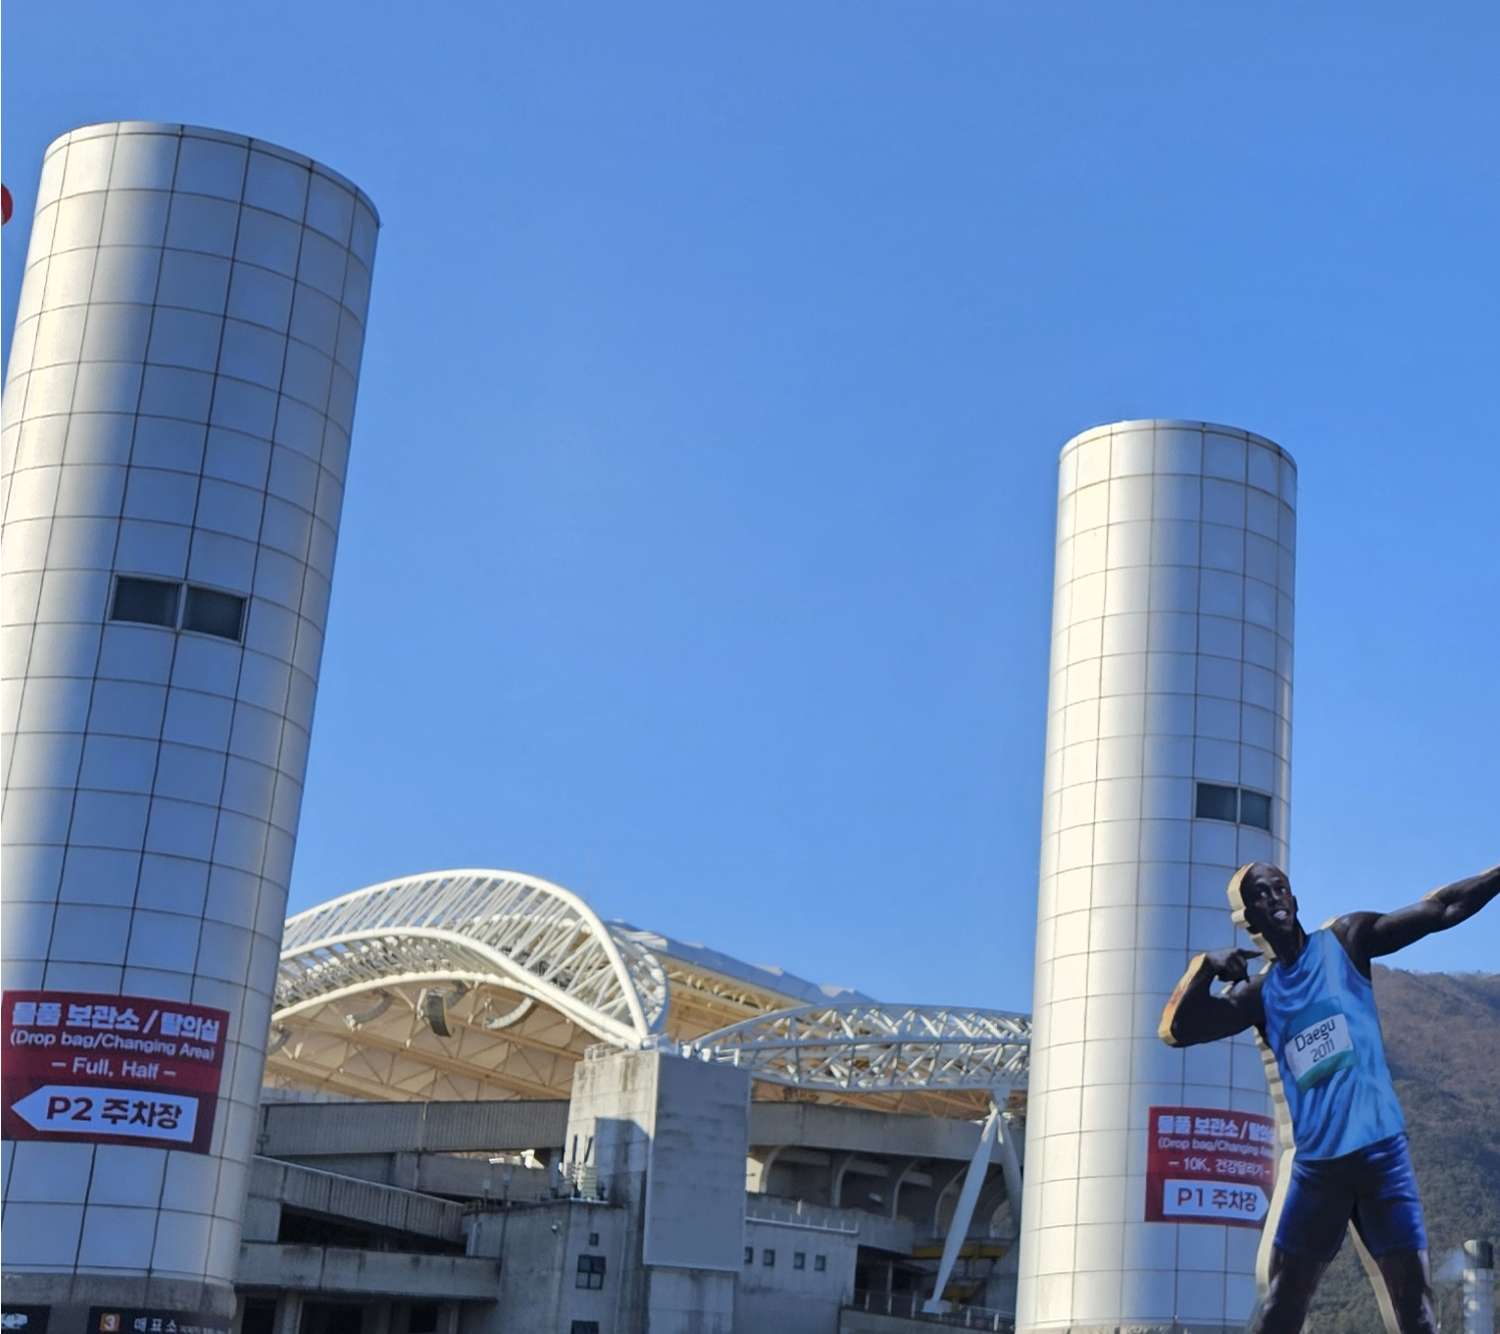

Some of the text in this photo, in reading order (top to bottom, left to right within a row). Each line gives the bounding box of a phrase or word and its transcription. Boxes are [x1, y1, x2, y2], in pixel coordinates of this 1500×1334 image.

[66, 1003, 140, 1032] 보관소
[10, 1029, 215, 1062] (Drop bag/Changing Area)
[1294, 1018, 1336, 1053] Daegu
[1310, 1038, 1336, 1063] 2011
[72, 1056, 114, 1078] Full,
[121, 1060, 160, 1080] Half
[46, 1095, 183, 1130] P2 주차장
[1177, 1187, 1258, 1213] P1 주차장
[103, 1314, 116, 1331] 3
